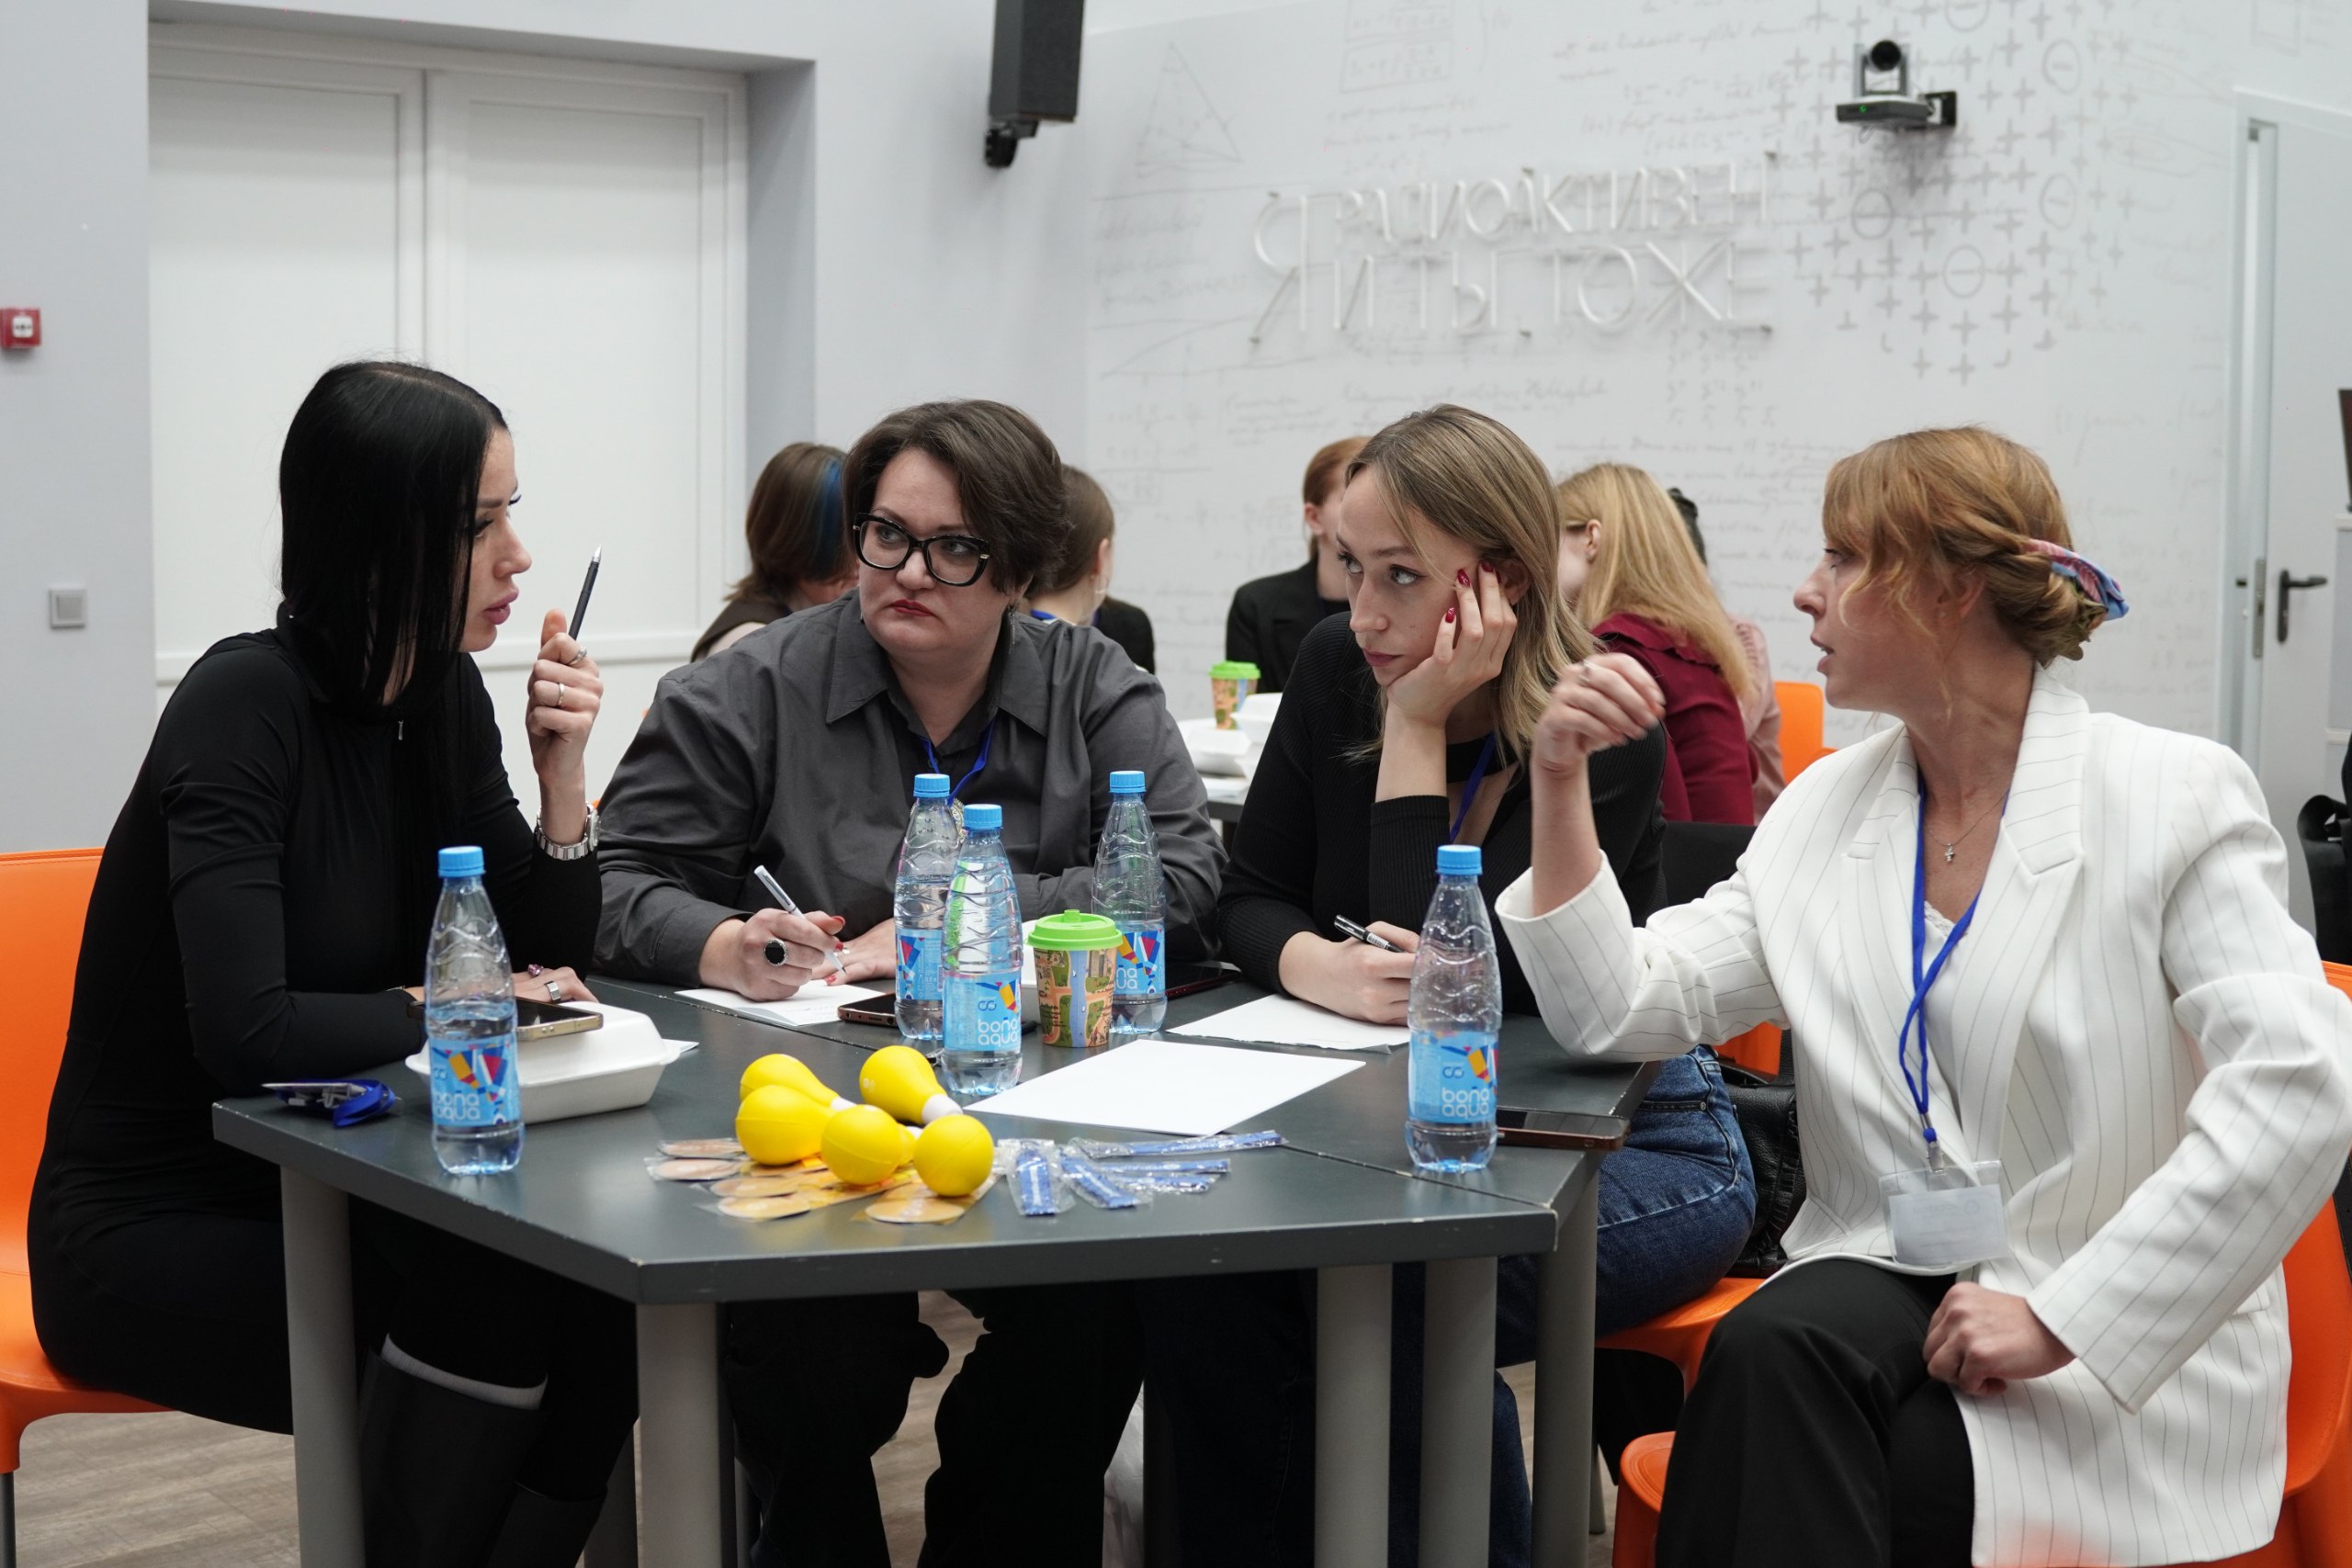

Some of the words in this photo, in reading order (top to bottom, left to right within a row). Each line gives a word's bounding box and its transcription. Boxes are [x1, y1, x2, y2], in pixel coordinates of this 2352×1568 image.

[1525, 238, 1772, 336] ТОЖЕ
[1116, 967, 1137, 978] na
[1116, 978, 1137, 989] ua
[978, 1032, 1018, 1047] aqua
[1442, 1102, 1489, 1120] aqua
